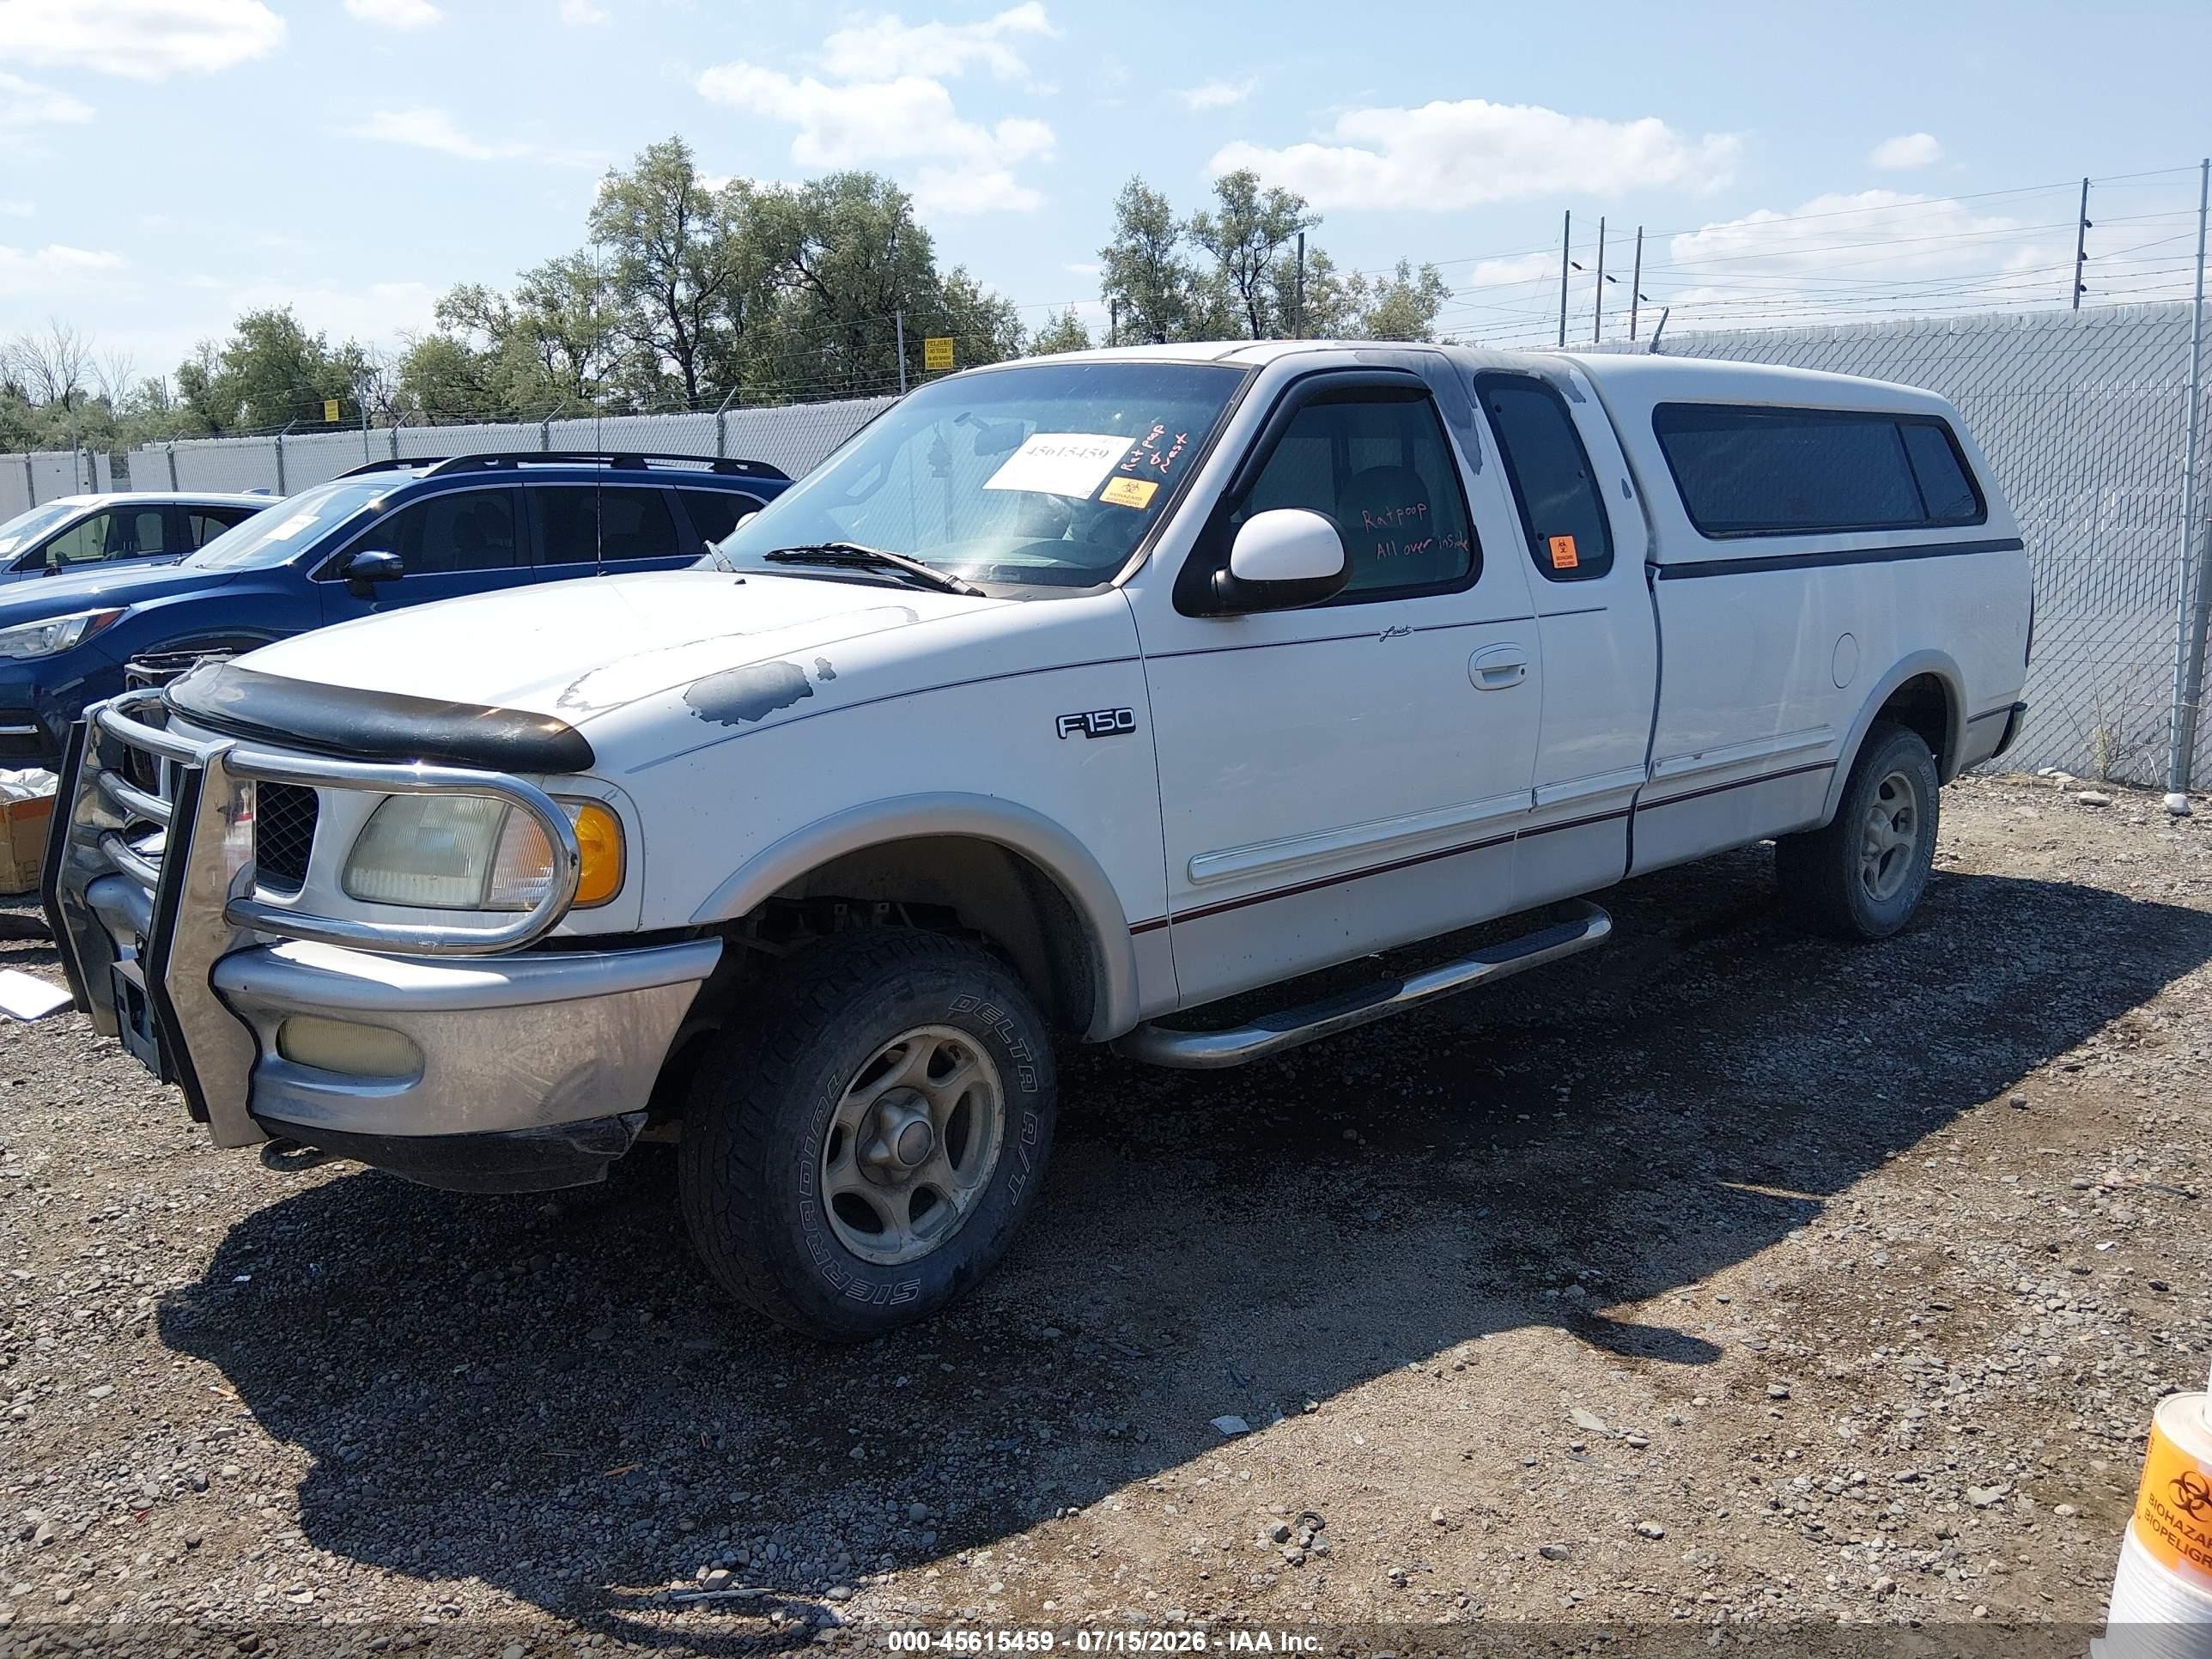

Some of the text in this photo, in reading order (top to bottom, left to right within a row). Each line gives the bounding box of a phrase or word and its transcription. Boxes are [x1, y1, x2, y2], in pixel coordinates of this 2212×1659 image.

[1120, 449, 1144, 471] Rat
[1376, 540, 1398, 561] All
[1403, 538, 1432, 556] over
[1058, 708, 1135, 738] F-150
[948, 993, 1038, 1093] DELTA
[1006, 1111, 1038, 1206] A/T
